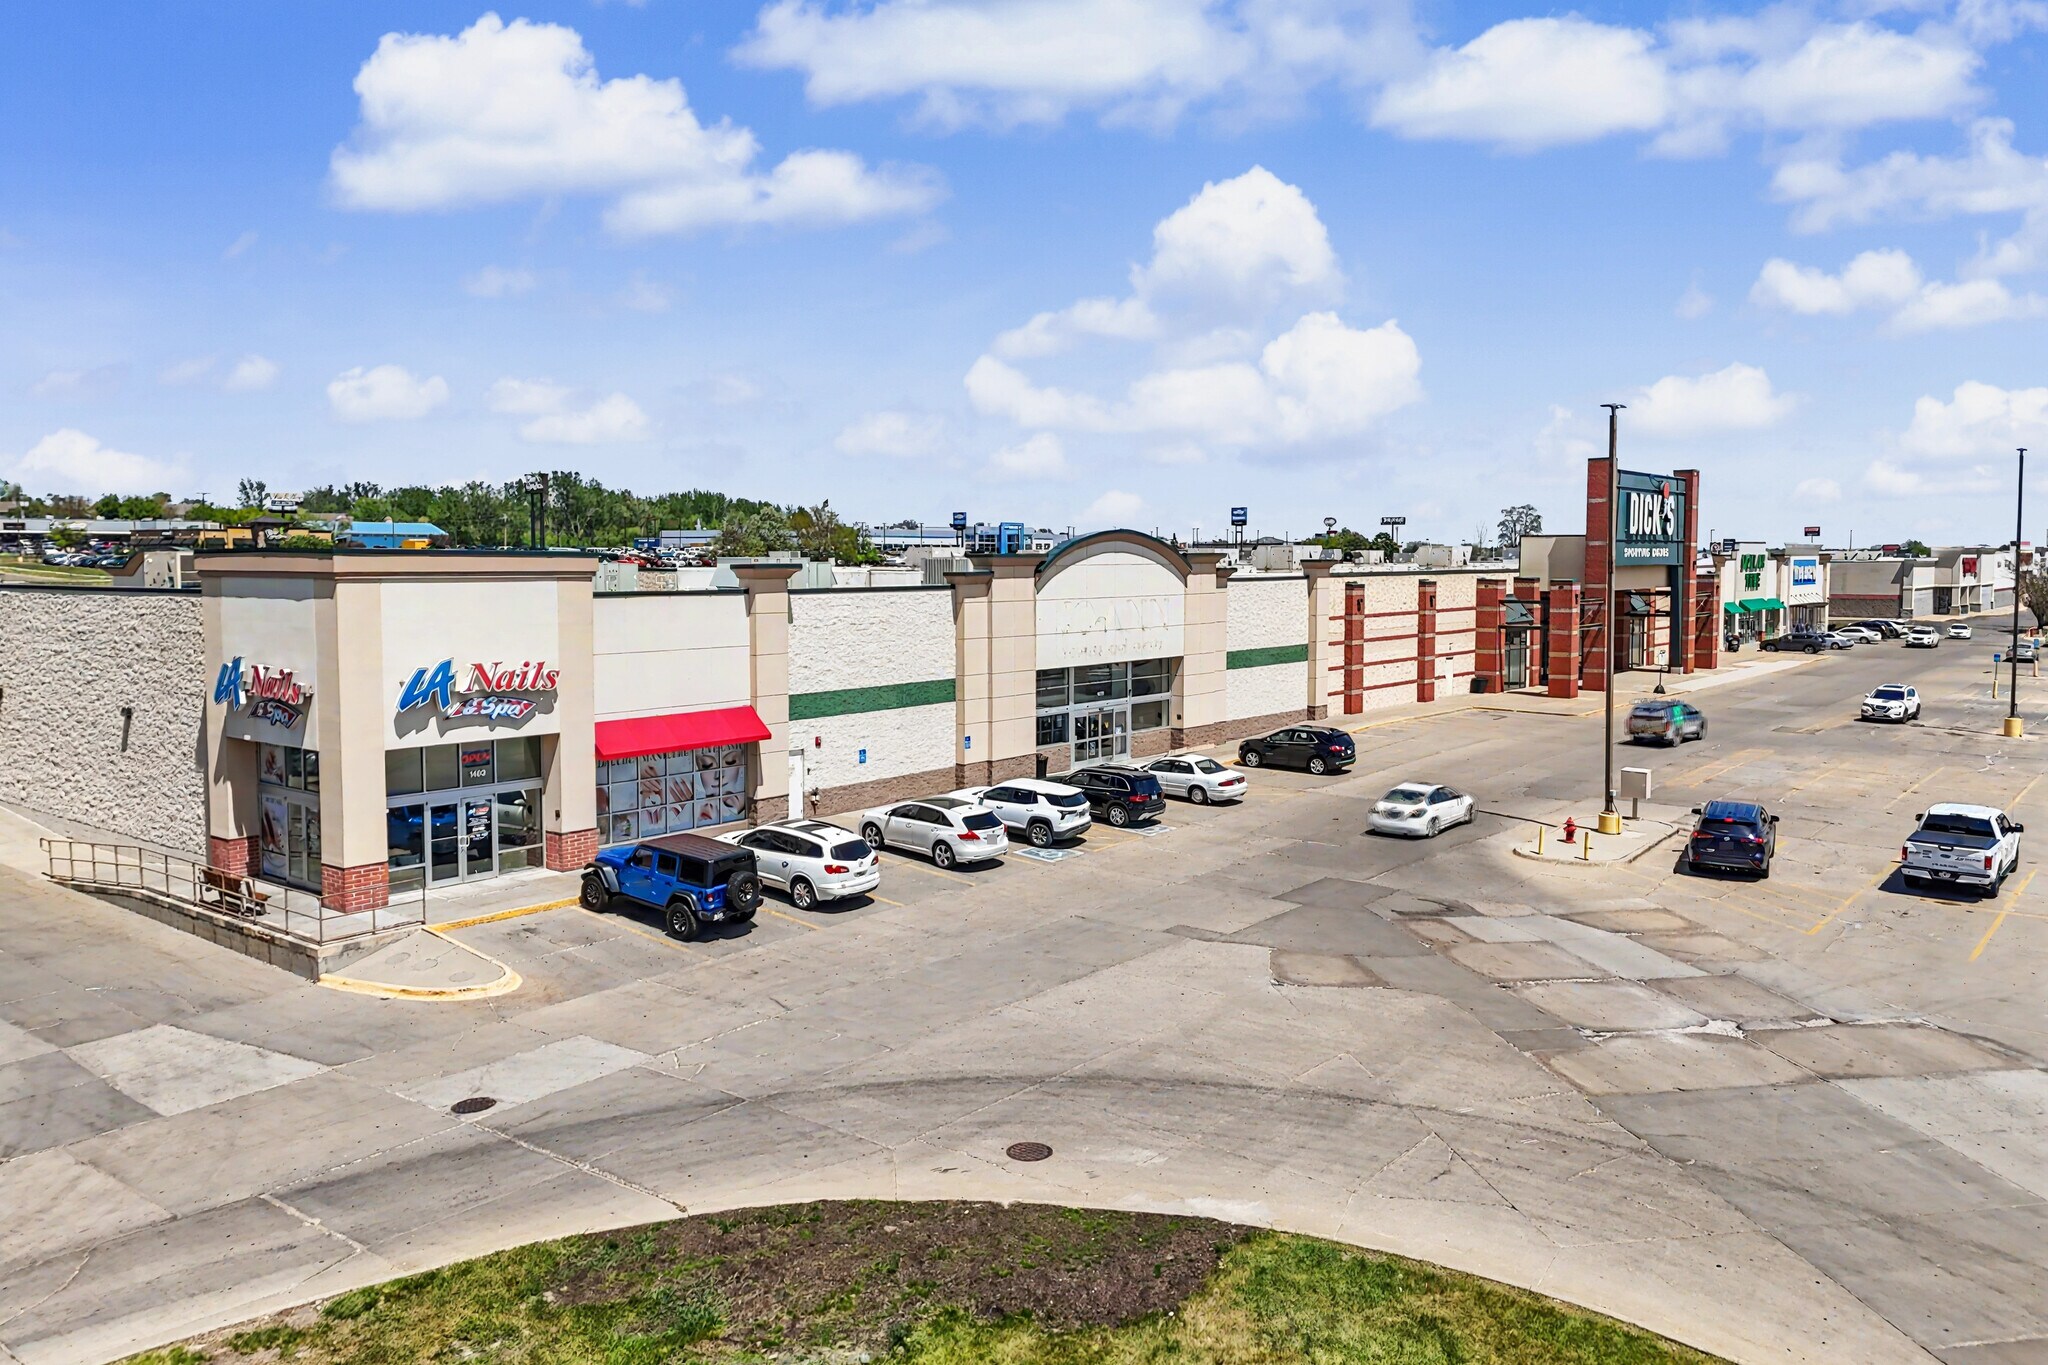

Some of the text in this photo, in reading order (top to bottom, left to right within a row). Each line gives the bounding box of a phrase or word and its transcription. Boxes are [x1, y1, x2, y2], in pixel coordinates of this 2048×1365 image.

[214, 656, 300, 712] LA Nails
[396, 658, 560, 712] LA Nails
[480, 696, 521, 720] Spa
